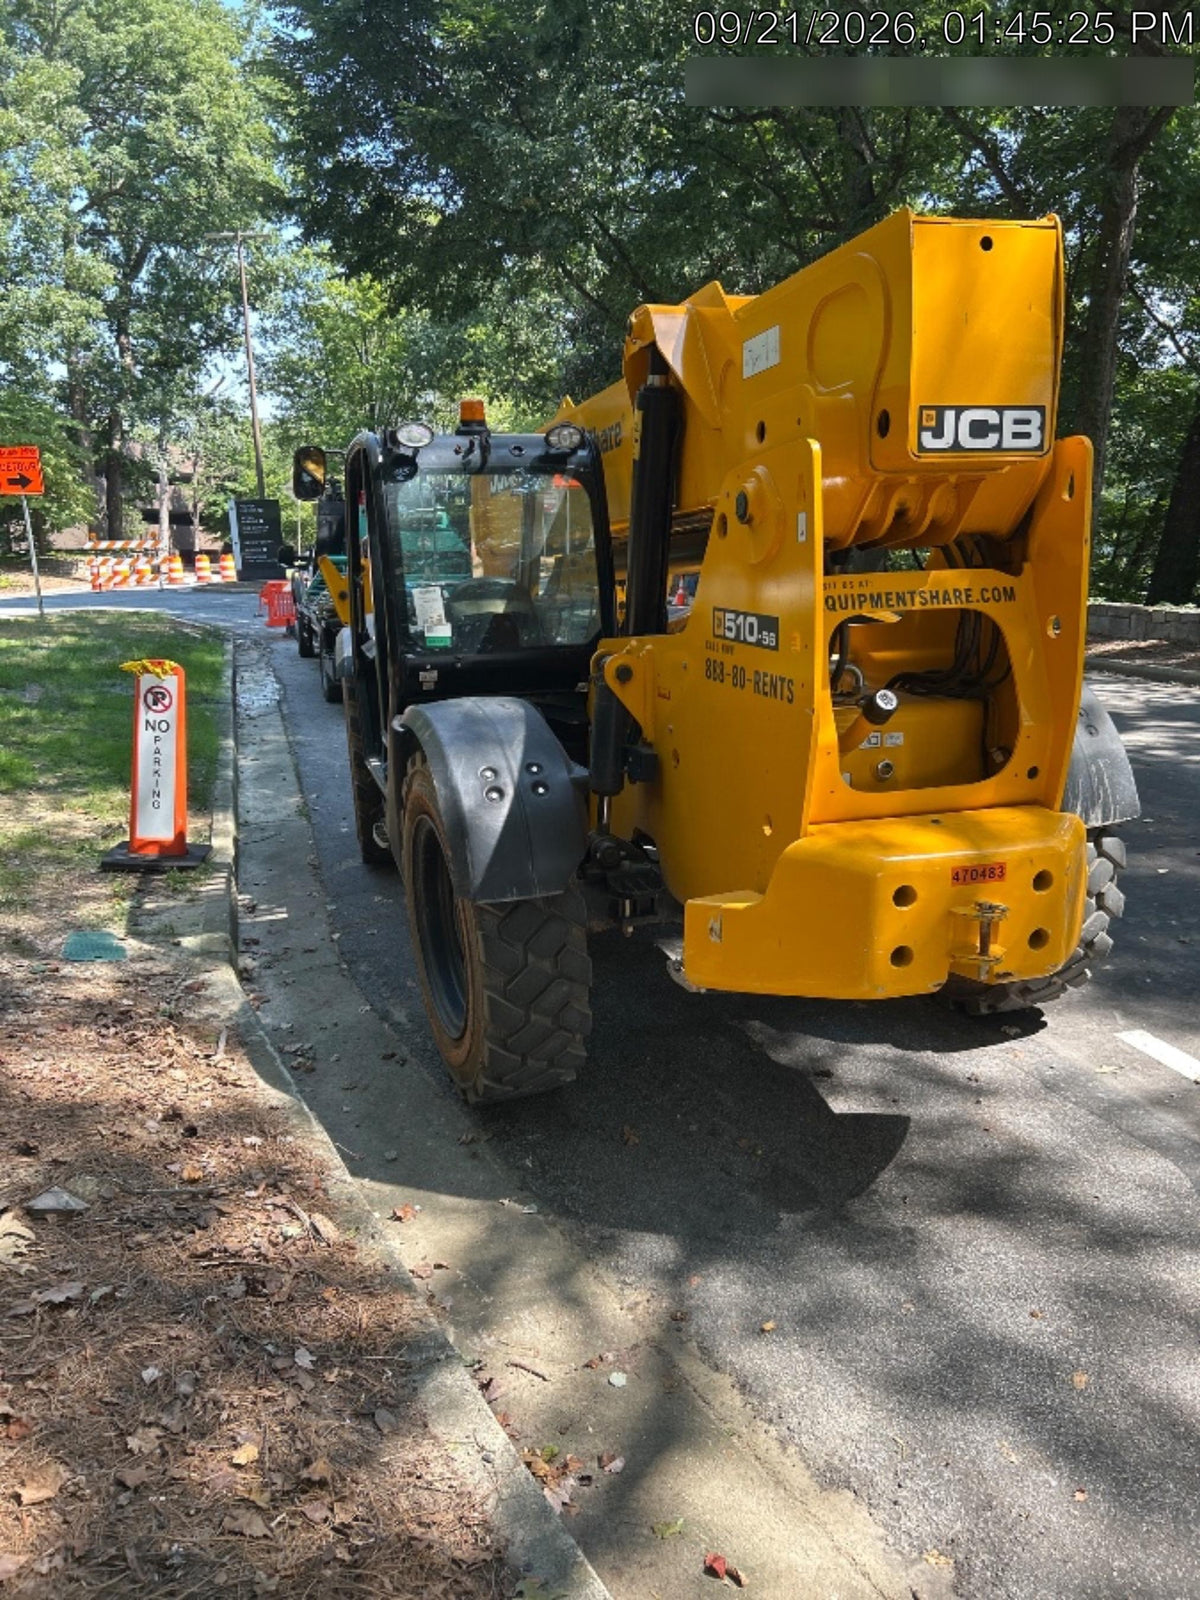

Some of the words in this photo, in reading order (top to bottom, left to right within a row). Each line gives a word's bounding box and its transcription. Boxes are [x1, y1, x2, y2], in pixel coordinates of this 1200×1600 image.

[920, 408, 1042, 449] JCB
[825, 586, 1017, 613] QUIPMENTSHARE.COM
[144, 719, 170, 734] NO
[152, 735, 163, 810] PARKING
[952, 864, 1005, 882] 470483
